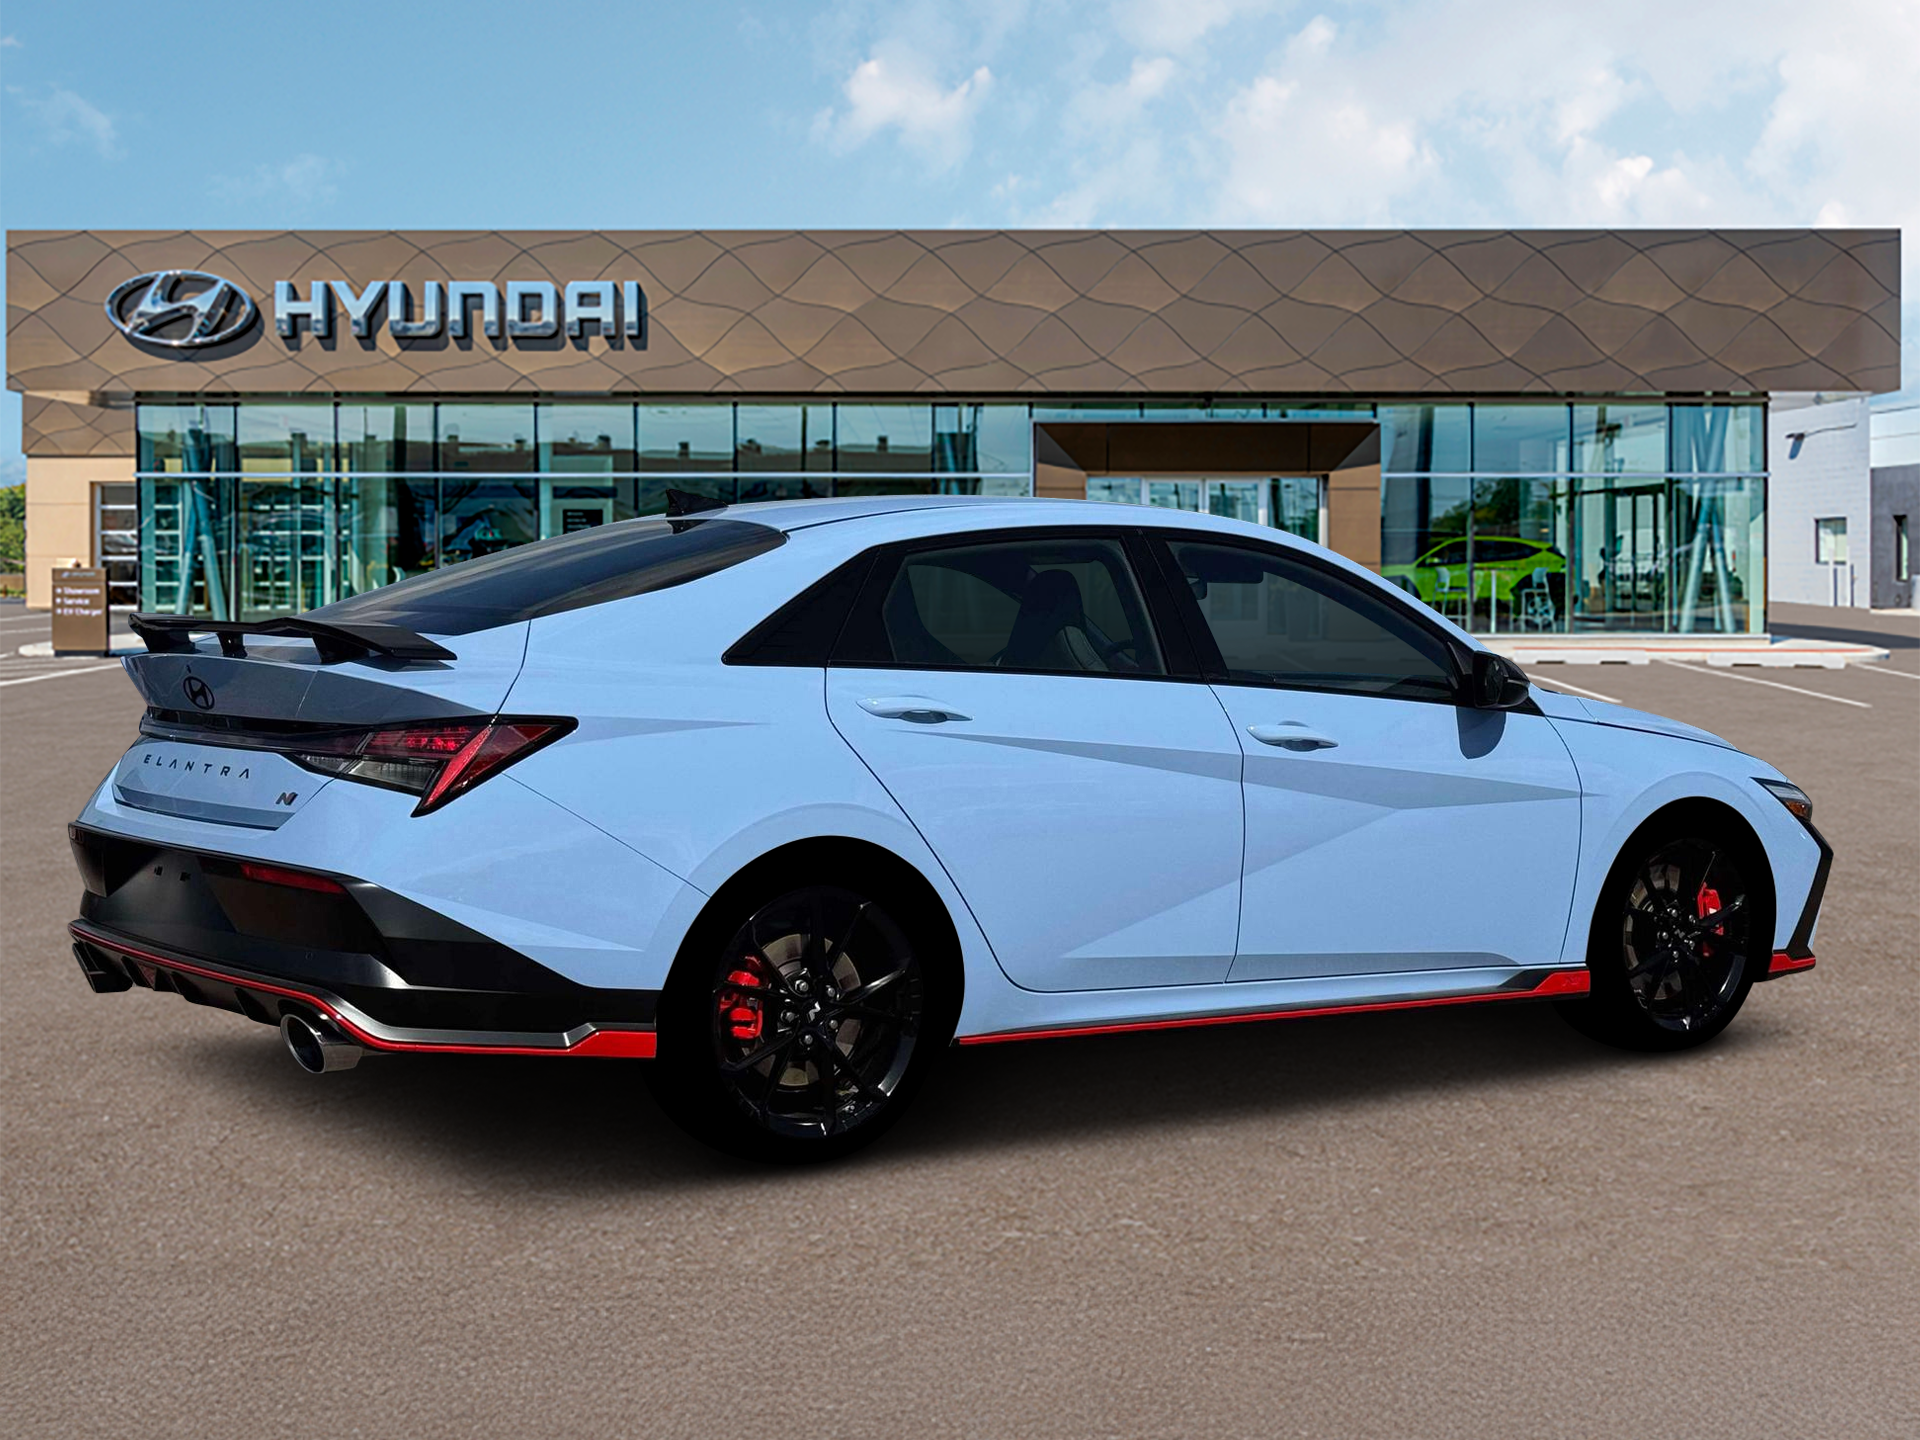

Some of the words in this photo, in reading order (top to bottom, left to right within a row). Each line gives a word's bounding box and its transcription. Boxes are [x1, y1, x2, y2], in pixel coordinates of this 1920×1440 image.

[274, 280, 641, 340] HYUNDAI
[143, 753, 250, 779] ELANTRA
[275, 791, 299, 806] N
